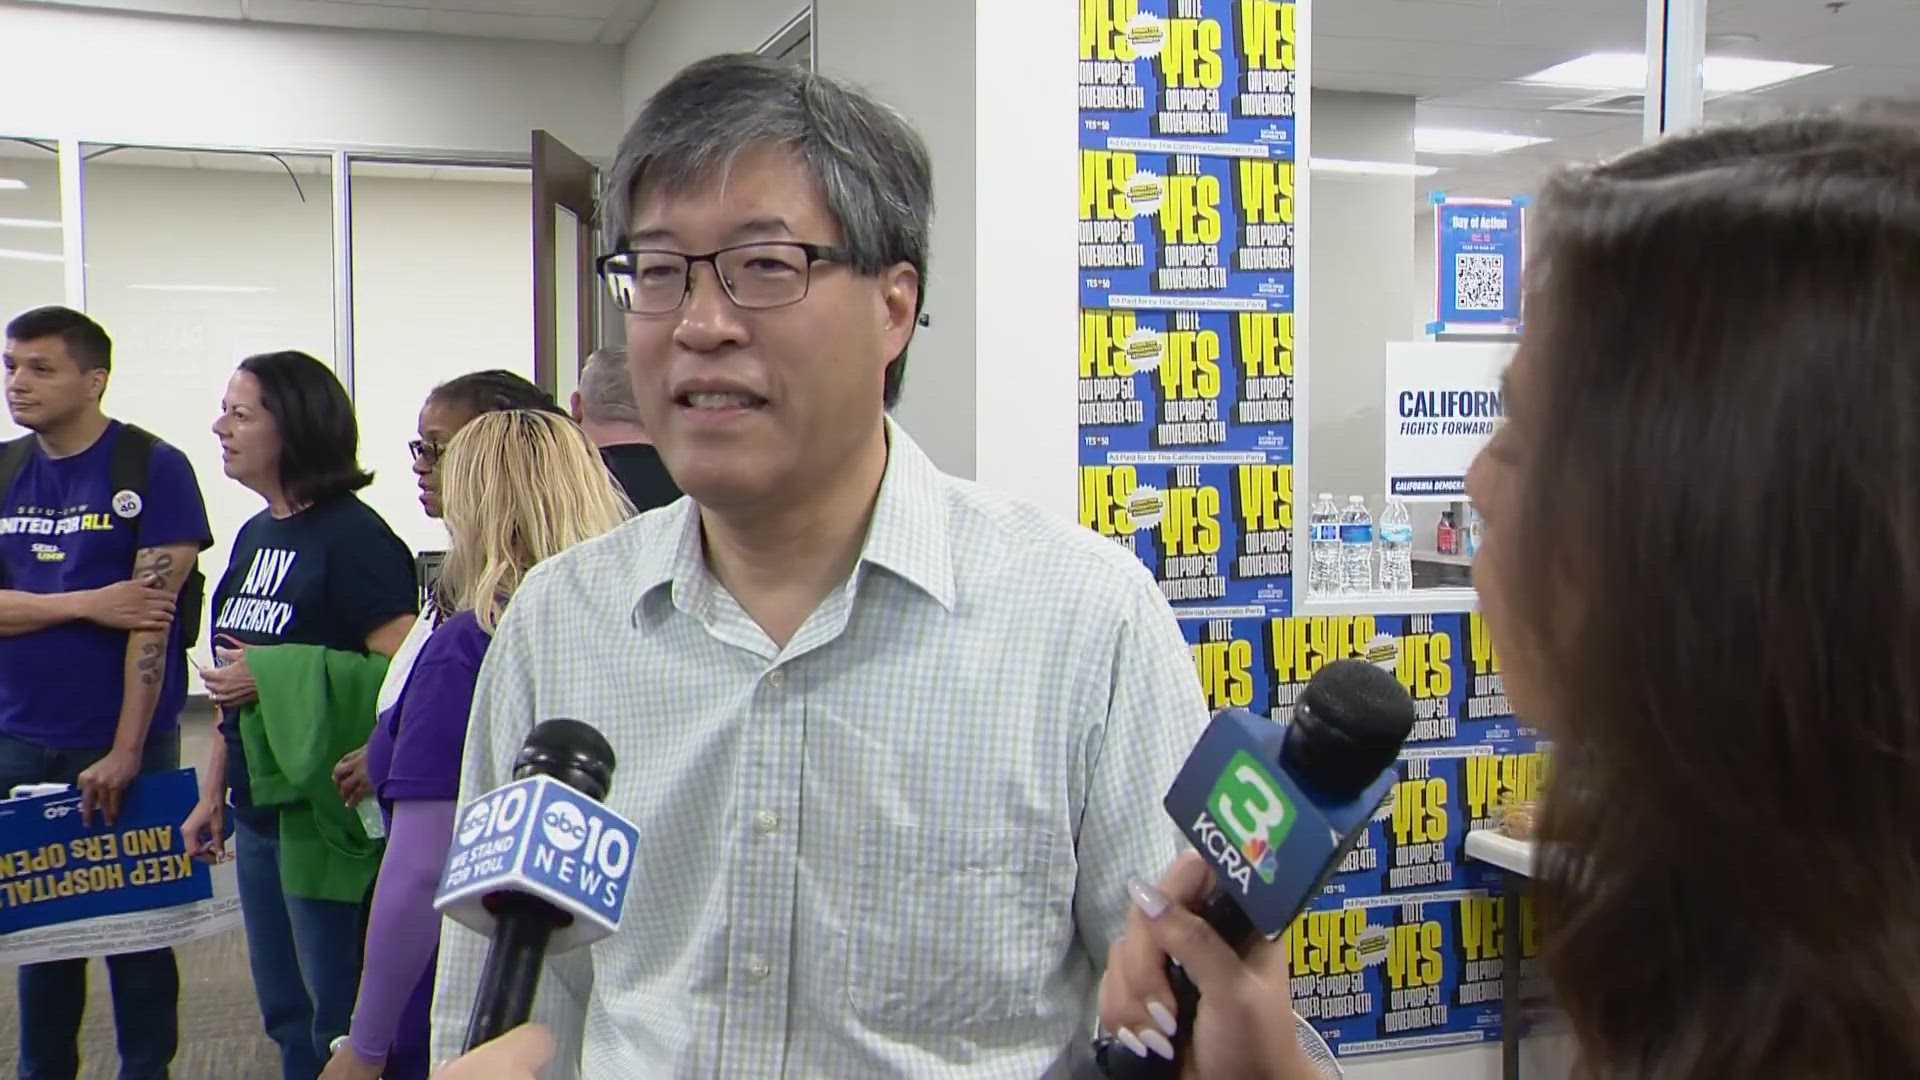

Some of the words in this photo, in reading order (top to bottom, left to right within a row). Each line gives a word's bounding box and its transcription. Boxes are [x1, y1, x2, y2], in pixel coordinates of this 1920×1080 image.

[1159, 19, 1222, 88] YES
[1094, 62, 1121, 84] PROP
[1122, 63, 1136, 84] 50
[1248, 71, 1262, 92] ON
[1263, 71, 1288, 92] PROP
[1079, 86, 1126, 109] OVEMBER
[1126, 86, 1144, 109] 4TH
[1166, 89, 1180, 110] ON
[1180, 89, 1205, 110] PROP
[1206, 89, 1219, 110] 50
[1241, 93, 1292, 116] NOVEMBER
[1159, 112, 1210, 134] NOVEMBER
[1210, 112, 1228, 133] 4TH
[1079, 150, 1136, 220] YES
[1158, 175, 1221, 244] YES
[1094, 221, 1121, 242] PROP
[1121, 221, 1135, 242] 50
[1453, 216, 1468, 230] Day
[1470, 216, 1479, 228] of
[1480, 216, 1507, 229] Action
[1246, 225, 1261, 246] ON
[1261, 225, 1287, 246] PROP
[1079, 245, 1126, 267] OVEMBER
[1126, 244, 1144, 266] 4TH
[1165, 246, 1179, 266] ON
[1180, 246, 1205, 266] PROP
[1205, 245, 1218, 266] 50
[1240, 248, 1290, 270] NOVEMBER
[1159, 268, 1210, 289] NOVEMBER
[1210, 268, 1227, 288] 4TH
[1079, 310, 1136, 377] YES
[1158, 331, 1221, 400] YES
[1094, 378, 1121, 399] PROP
[1121, 378, 1135, 399] 50
[1246, 379, 1261, 400] ON
[1261, 378, 1287, 400] PROP
[1079, 401, 1126, 424] OVEMBER
[1126, 400, 1143, 423] 4TH
[1165, 401, 1179, 421] ON
[1179, 400, 1204, 421] PROP
[1205, 400, 1217, 420] 50
[1239, 401, 1290, 423] NOVEMBER
[1399, 391, 1504, 418] CALIFORN
[1158, 422, 1210, 445] NOVEMBER
[1210, 421, 1226, 443] 4TH
[1400, 422, 1438, 435] FIGHTS
[1441, 422, 1493, 435] FORWARD
[1176, 466, 1200, 486] VOTE
[1395, 481, 1433, 491] CALIFORNIA
[1079, 465, 1136, 534] YES
[0, 517, 54, 535] NITED
[55, 515, 80, 535] FOR
[81, 513, 113, 530] ALL
[1158, 486, 1221, 556] YES
[1246, 533, 1260, 553] ON
[1261, 531, 1286, 553] PROP
[240, 548, 296, 597] AMY
[1165, 557, 1179, 577] ON
[1180, 556, 1204, 577] PROP
[1205, 556, 1217, 576] 50
[1239, 554, 1289, 576] NOVEMBER
[1208, 576, 1225, 597] 4TH
[1208, 619, 1233, 641] VOTE
[1411, 614, 1433, 633] VOTE
[1394, 632, 1451, 698] YES
[1440, 718, 1456, 739] 4TH
[1408, 758, 1430, 779] VOTE
[484, 787, 528, 838] 10
[1218, 765, 1284, 842] 3
[1392, 778, 1447, 845] YES
[123, 825, 172, 856] AND
[469, 836, 514, 862] STAND
[544, 812, 586, 840] abc
[583, 815, 630, 879] 10
[0, 843, 66, 880] OPEN
[1192, 811, 1251, 895] KCRA
[1396, 847, 1409, 866] ON
[1409, 845, 1432, 865] PROP
[1433, 843, 1445, 861] 50
[130, 852, 193, 885] KEEP
[533, 844, 619, 908] NEWS
[1390, 864, 1434, 888] NOVEMBER
[1435, 862, 1452, 883] 4TH
[1402, 902, 1424, 923] VOTE
[1461, 897, 1504, 960] YE
[1386, 921, 1442, 989] YES
[1391, 989, 1404, 1010] ON
[1404, 986, 1427, 1009] PROP
[1385, 1007, 1431, 1032] NOVEMBER
